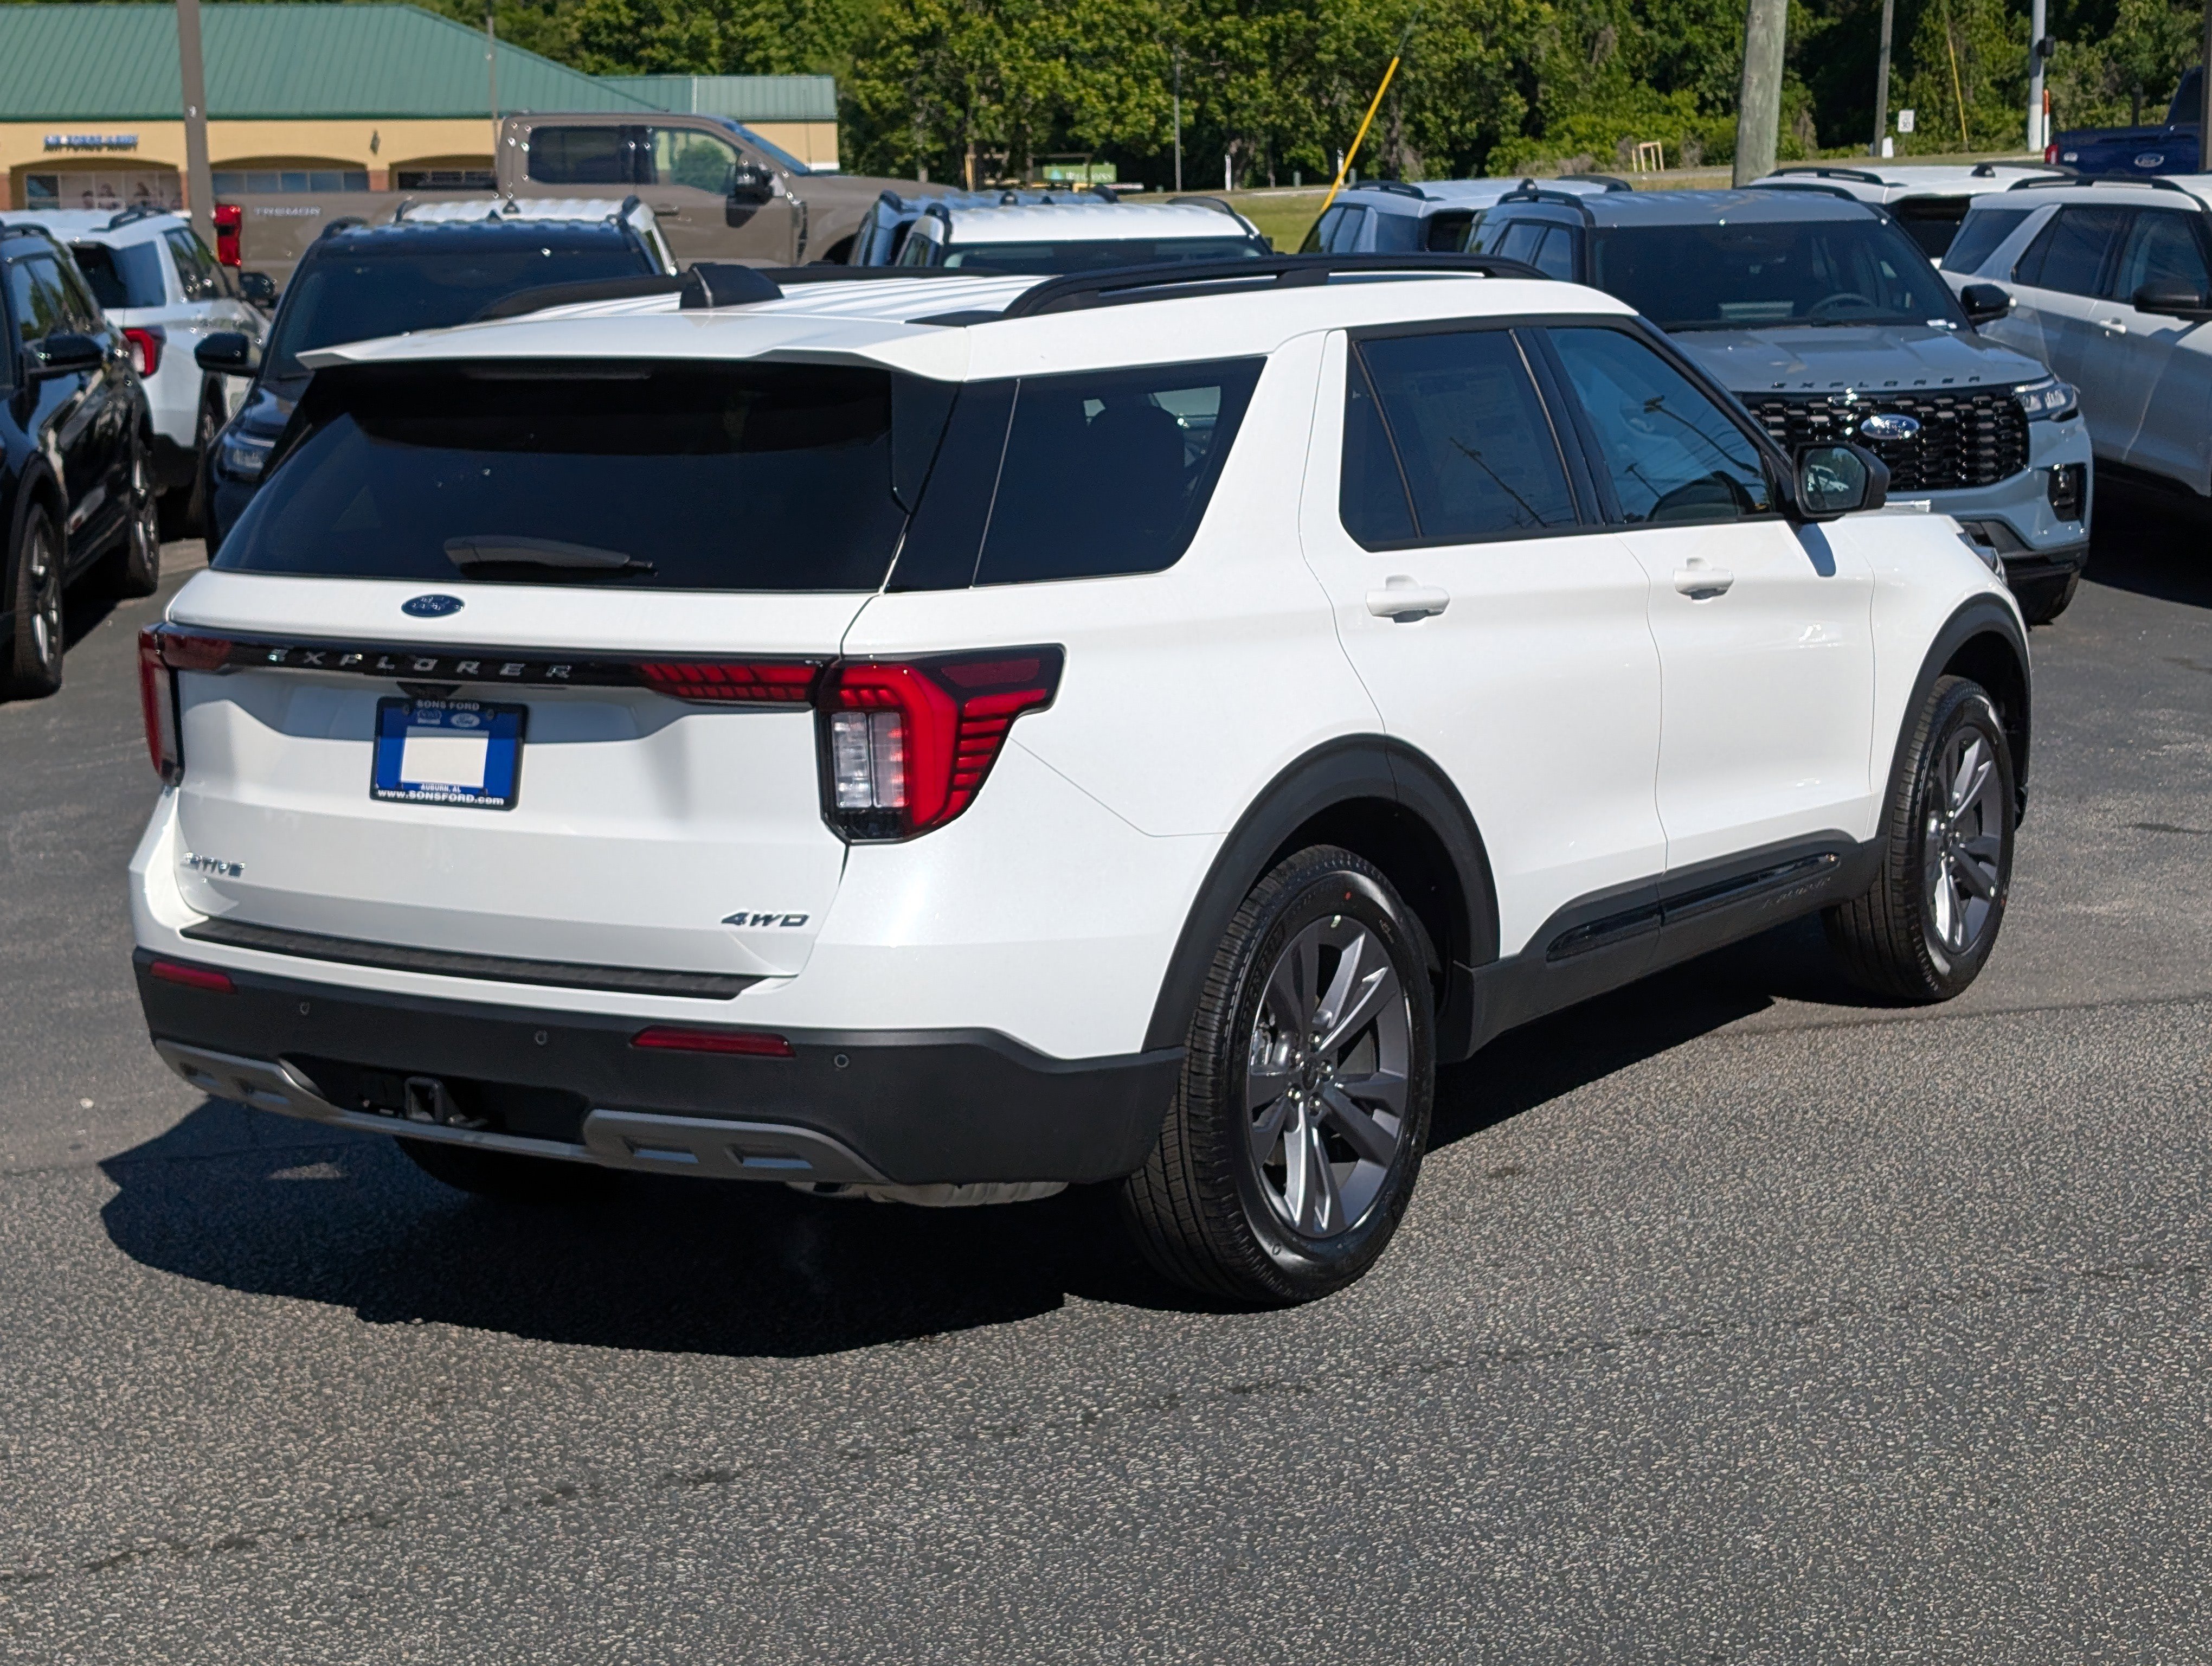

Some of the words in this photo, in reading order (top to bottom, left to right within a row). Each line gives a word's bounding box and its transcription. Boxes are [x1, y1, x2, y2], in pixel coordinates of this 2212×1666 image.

[254, 207, 321, 216] TREMOR
[268, 649, 572, 678] EXPLORER
[417, 700, 446, 709] SONS
[449, 702, 480, 711] FORD
[378, 790, 504, 806] www.SONSFORD.com
[721, 912, 810, 927] 4WD
